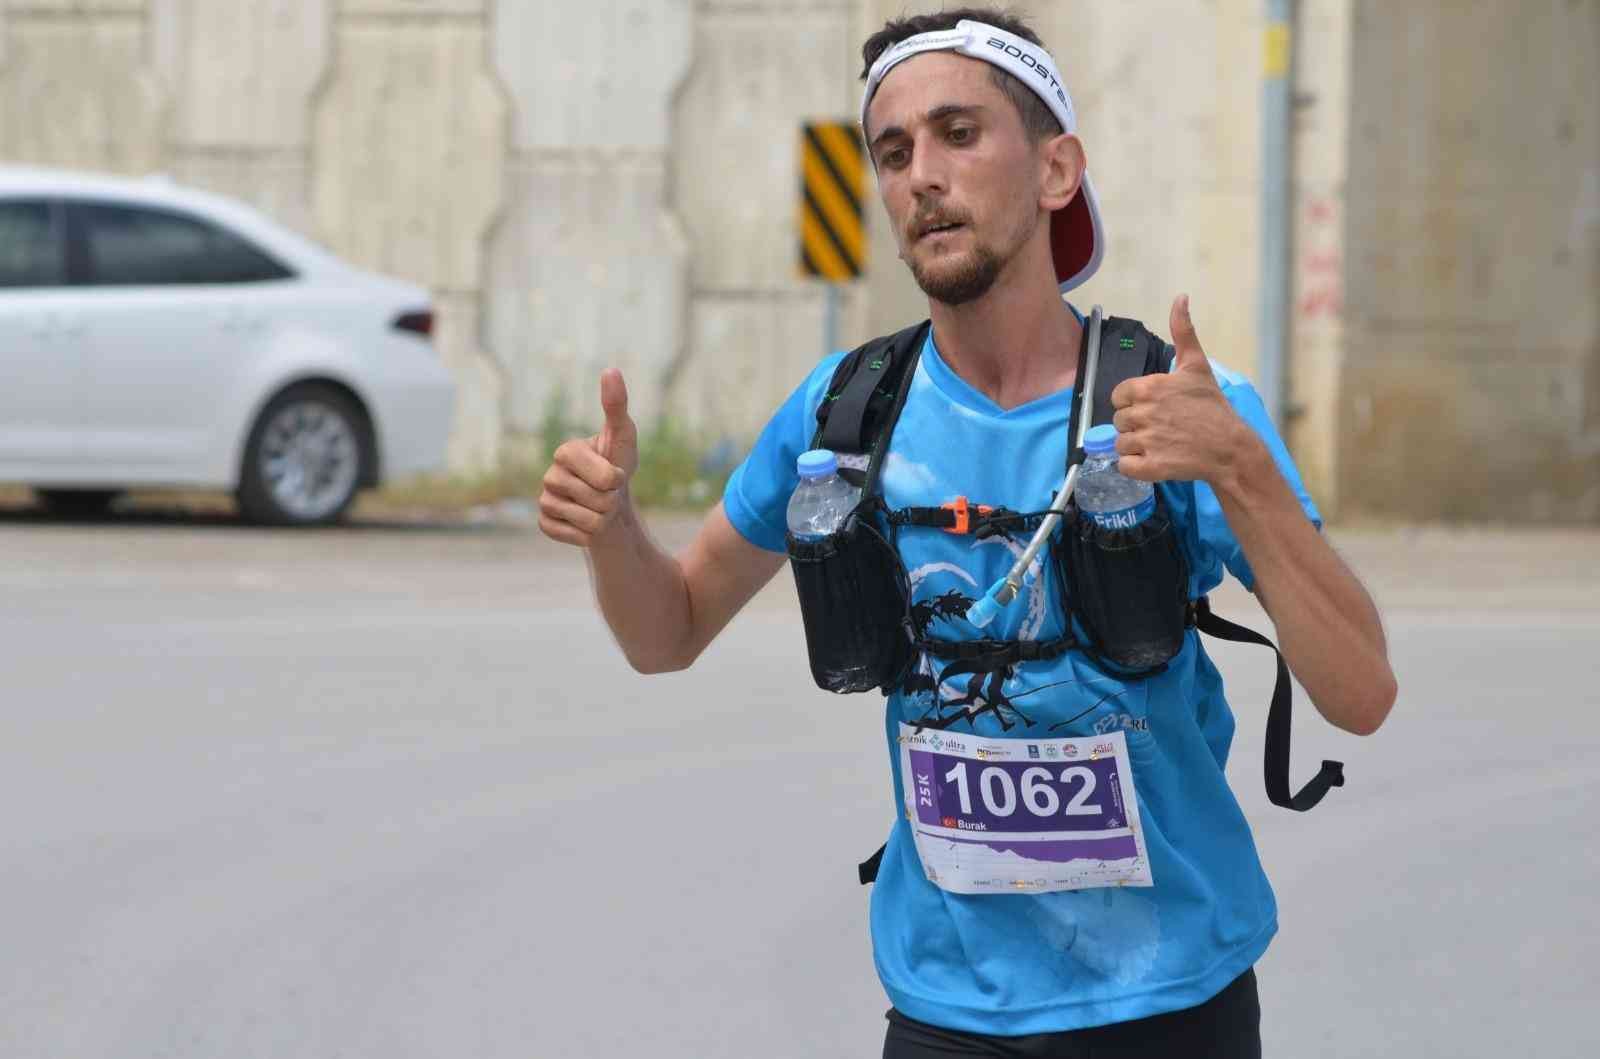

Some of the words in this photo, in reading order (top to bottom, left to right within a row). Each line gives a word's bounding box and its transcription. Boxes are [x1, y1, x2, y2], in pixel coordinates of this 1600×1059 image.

[986, 36, 1069, 111] BOOSTE
[917, 773, 932, 807] 25K
[945, 761, 1103, 817] 1062
[958, 819, 987, 831] Burak
